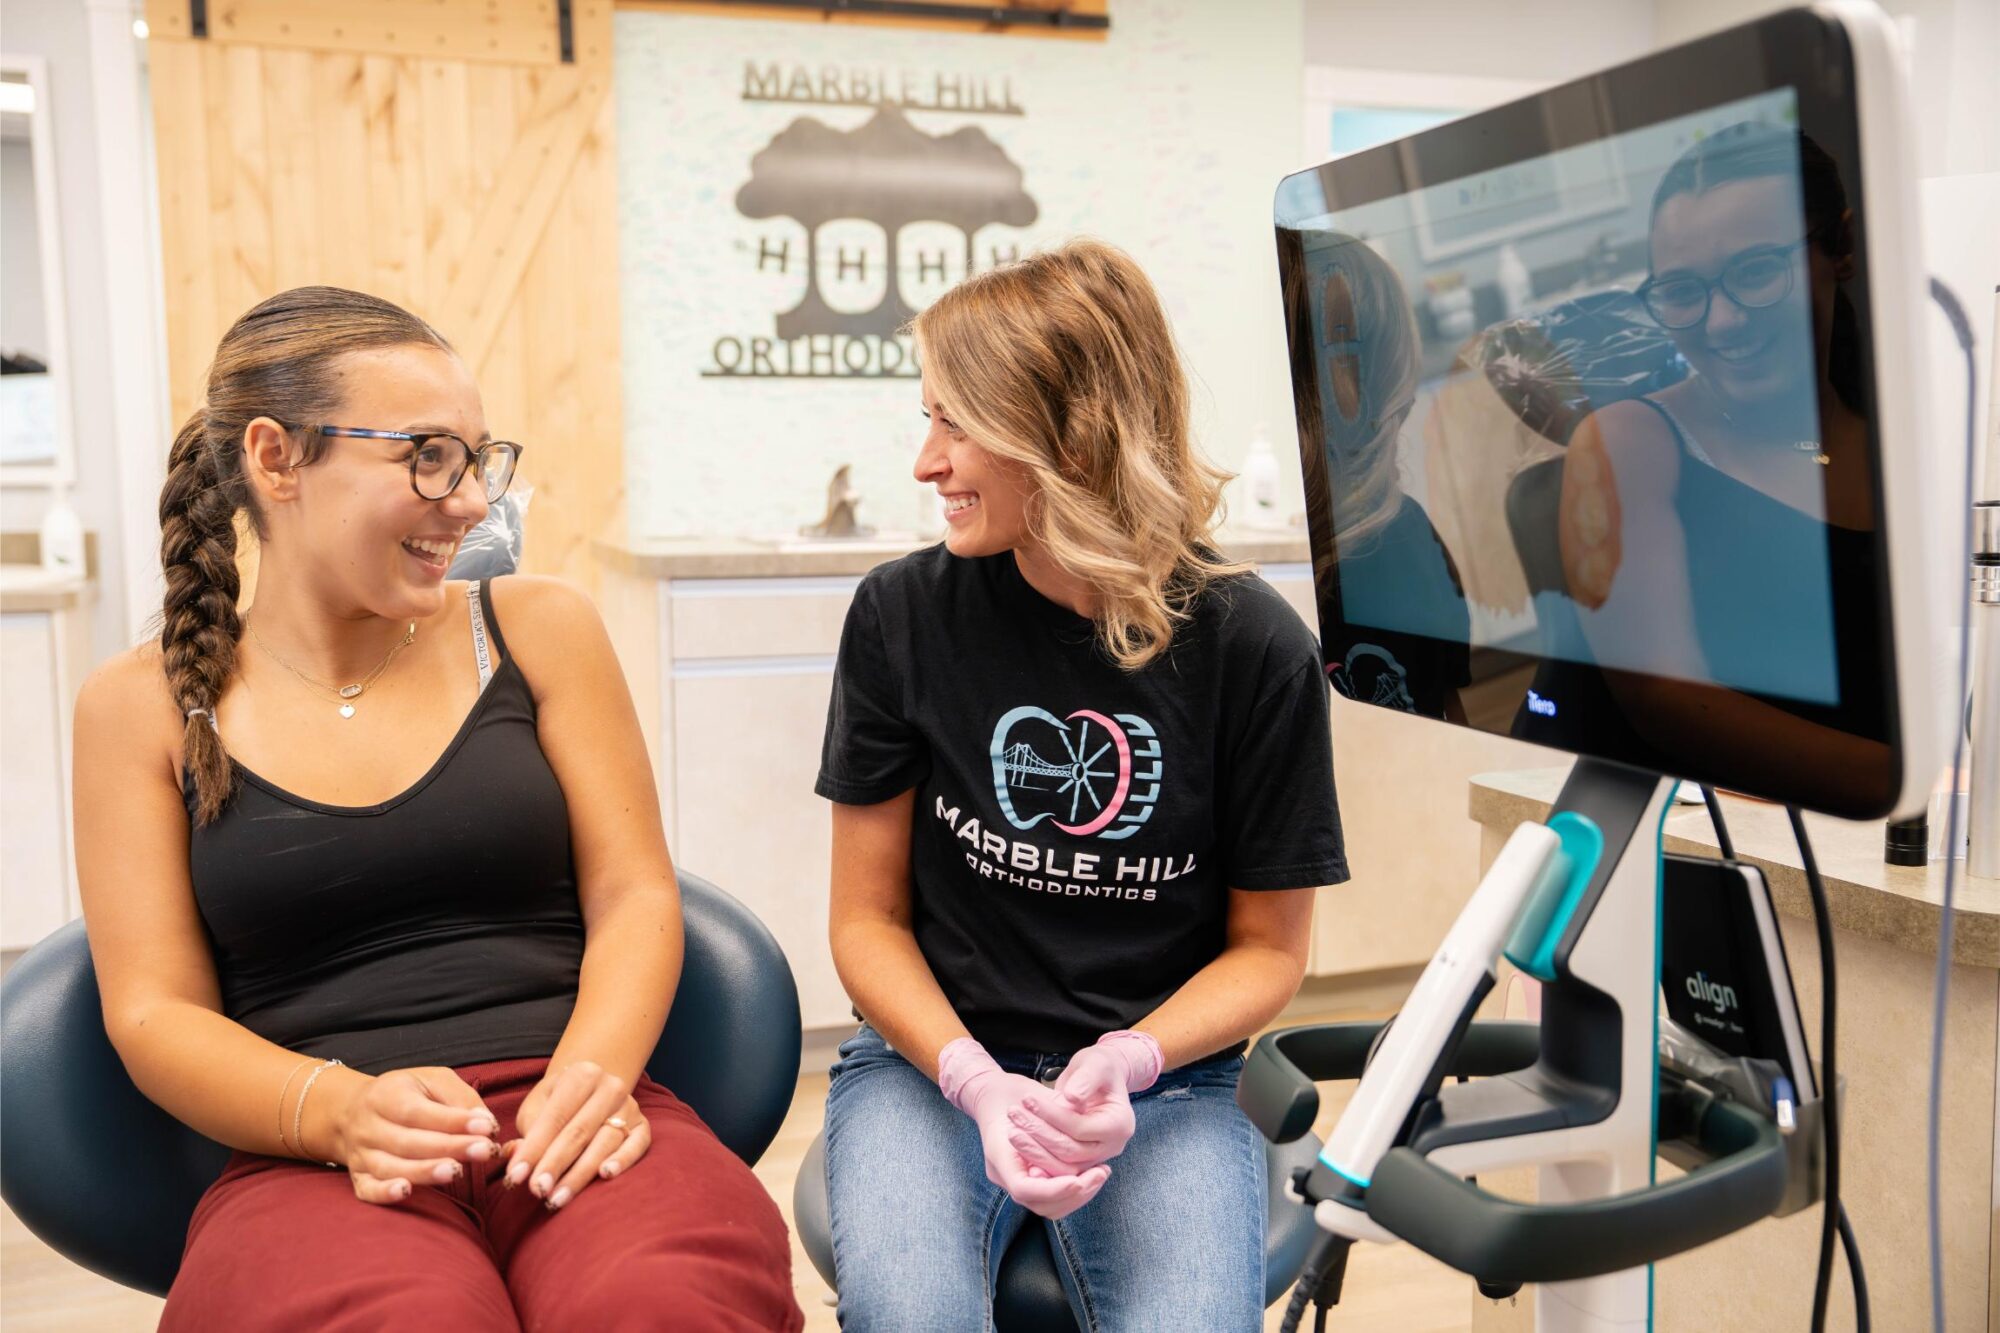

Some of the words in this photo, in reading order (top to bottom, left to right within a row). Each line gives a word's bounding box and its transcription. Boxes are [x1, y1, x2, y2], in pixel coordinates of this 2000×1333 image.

[744, 61, 919, 106] MARBLE
[936, 71, 1023, 112] HILL
[935, 795, 1100, 881] MARBLE
[1115, 853, 1197, 883] HILL
[965, 852, 1157, 902] ORTHODONTICS
[1685, 970, 1739, 1013] align
